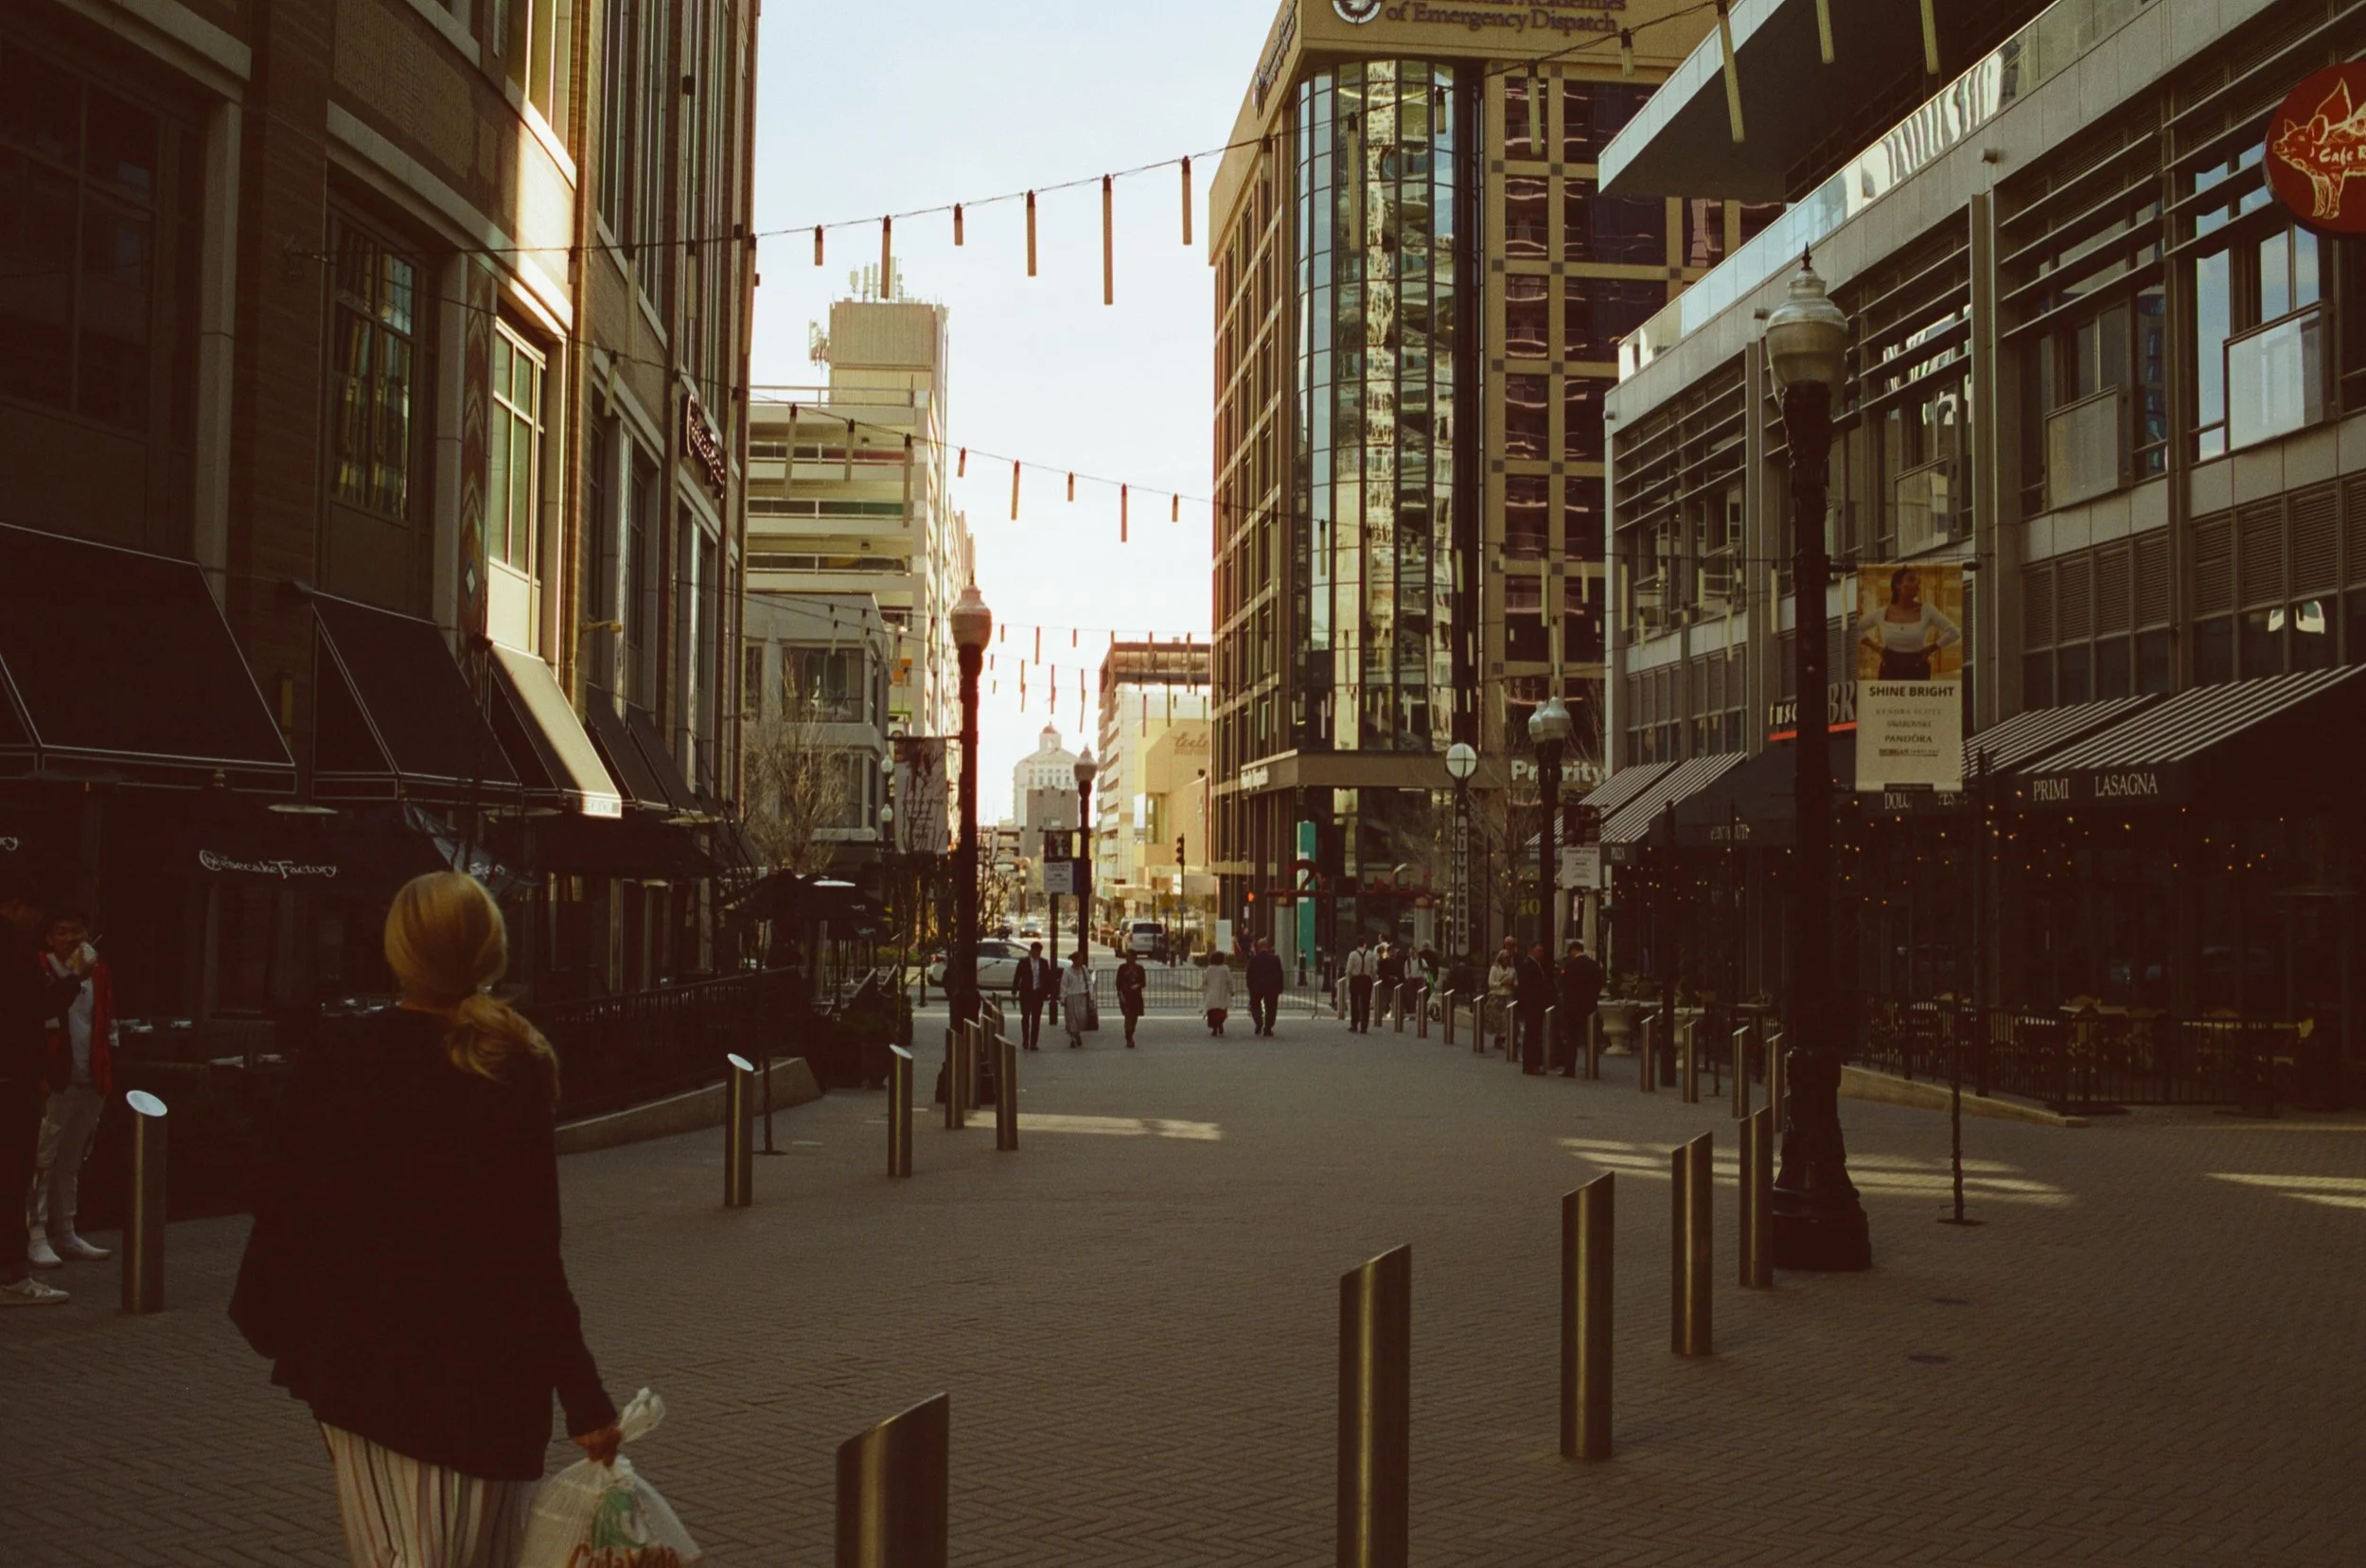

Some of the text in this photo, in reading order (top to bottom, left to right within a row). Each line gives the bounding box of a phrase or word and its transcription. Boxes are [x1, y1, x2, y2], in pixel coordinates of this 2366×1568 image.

[1386, 1, 1618, 36] of Emergency Dispatch
[2319, 146, 2355, 166] Cafe
[1868, 686, 1955, 697] SHINE BRIGHT
[1511, 760, 1605, 788] Prrity
[2033, 773, 2159, 802] PRIMI LASAGNA
[268, 859, 337, 880] Factory
